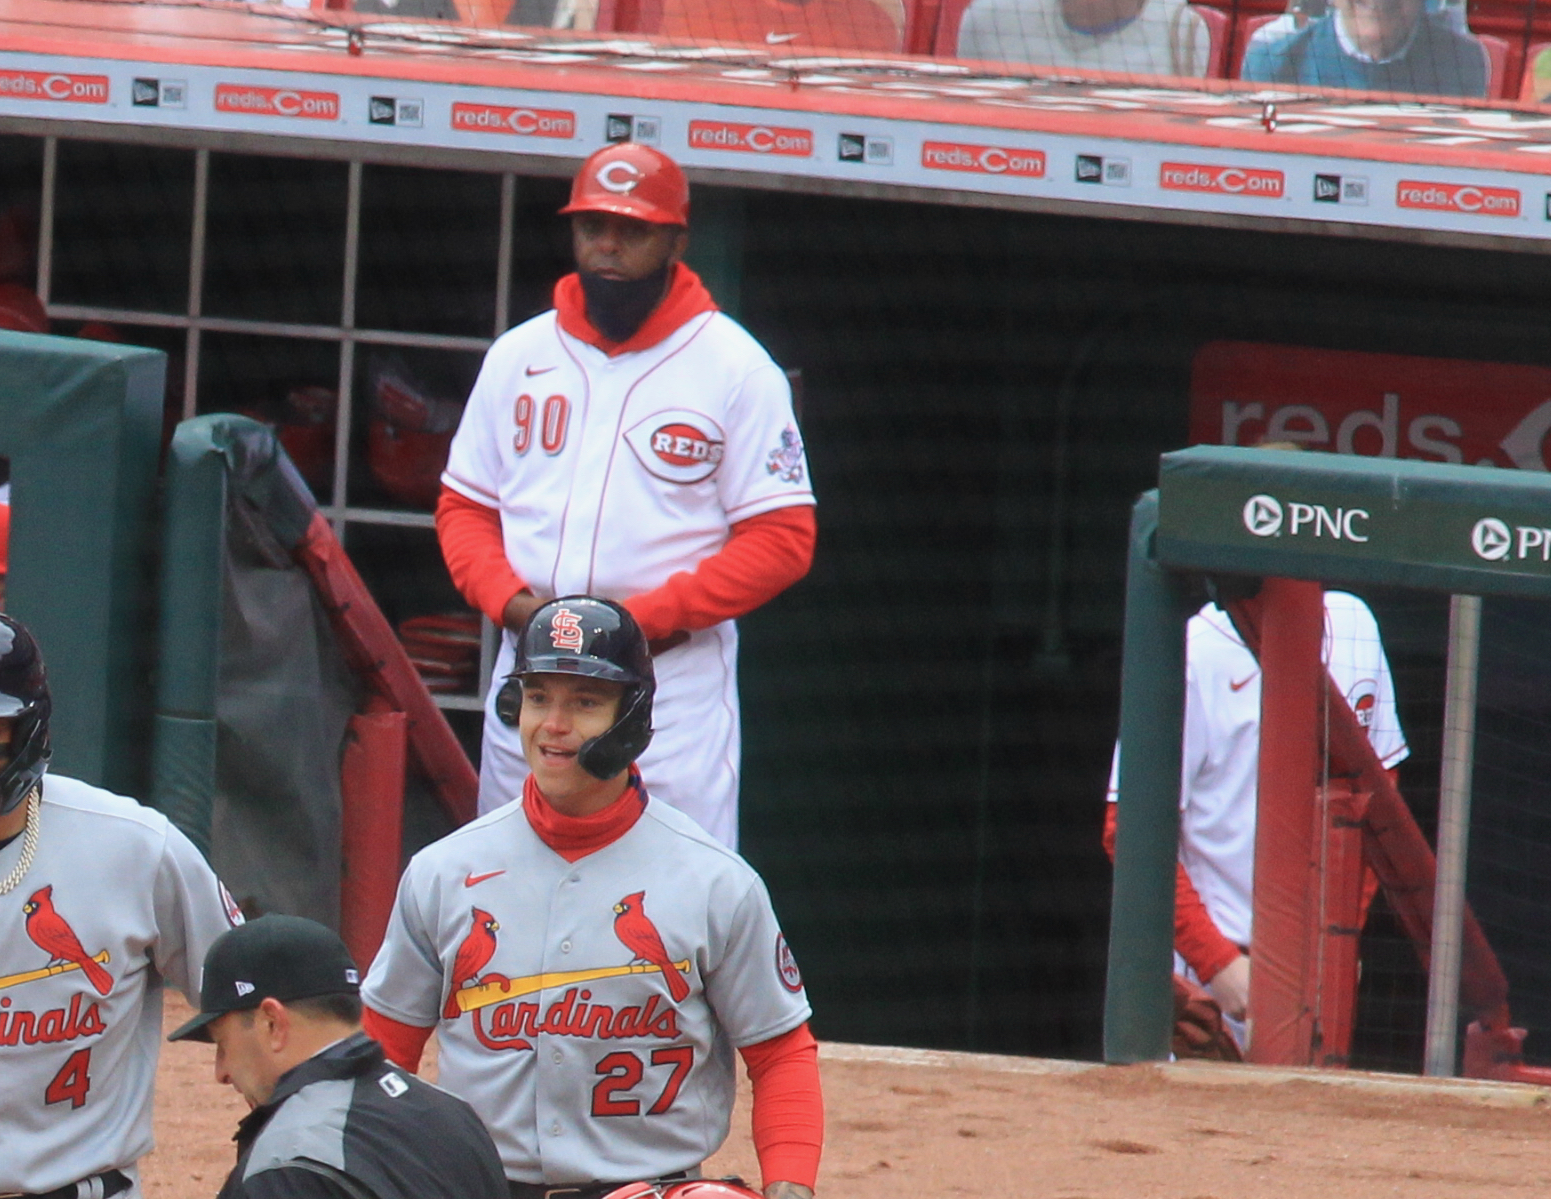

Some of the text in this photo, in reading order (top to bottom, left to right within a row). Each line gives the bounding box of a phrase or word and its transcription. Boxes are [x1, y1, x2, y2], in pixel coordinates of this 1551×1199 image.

[513, 394, 570, 456] 90
[652, 431, 724, 463] REDS
[1288, 502, 1369, 543] PNC
[469, 973, 683, 1051] Cardinals
[44, 1048, 92, 1110] 4
[590, 1046, 695, 1117] 27
